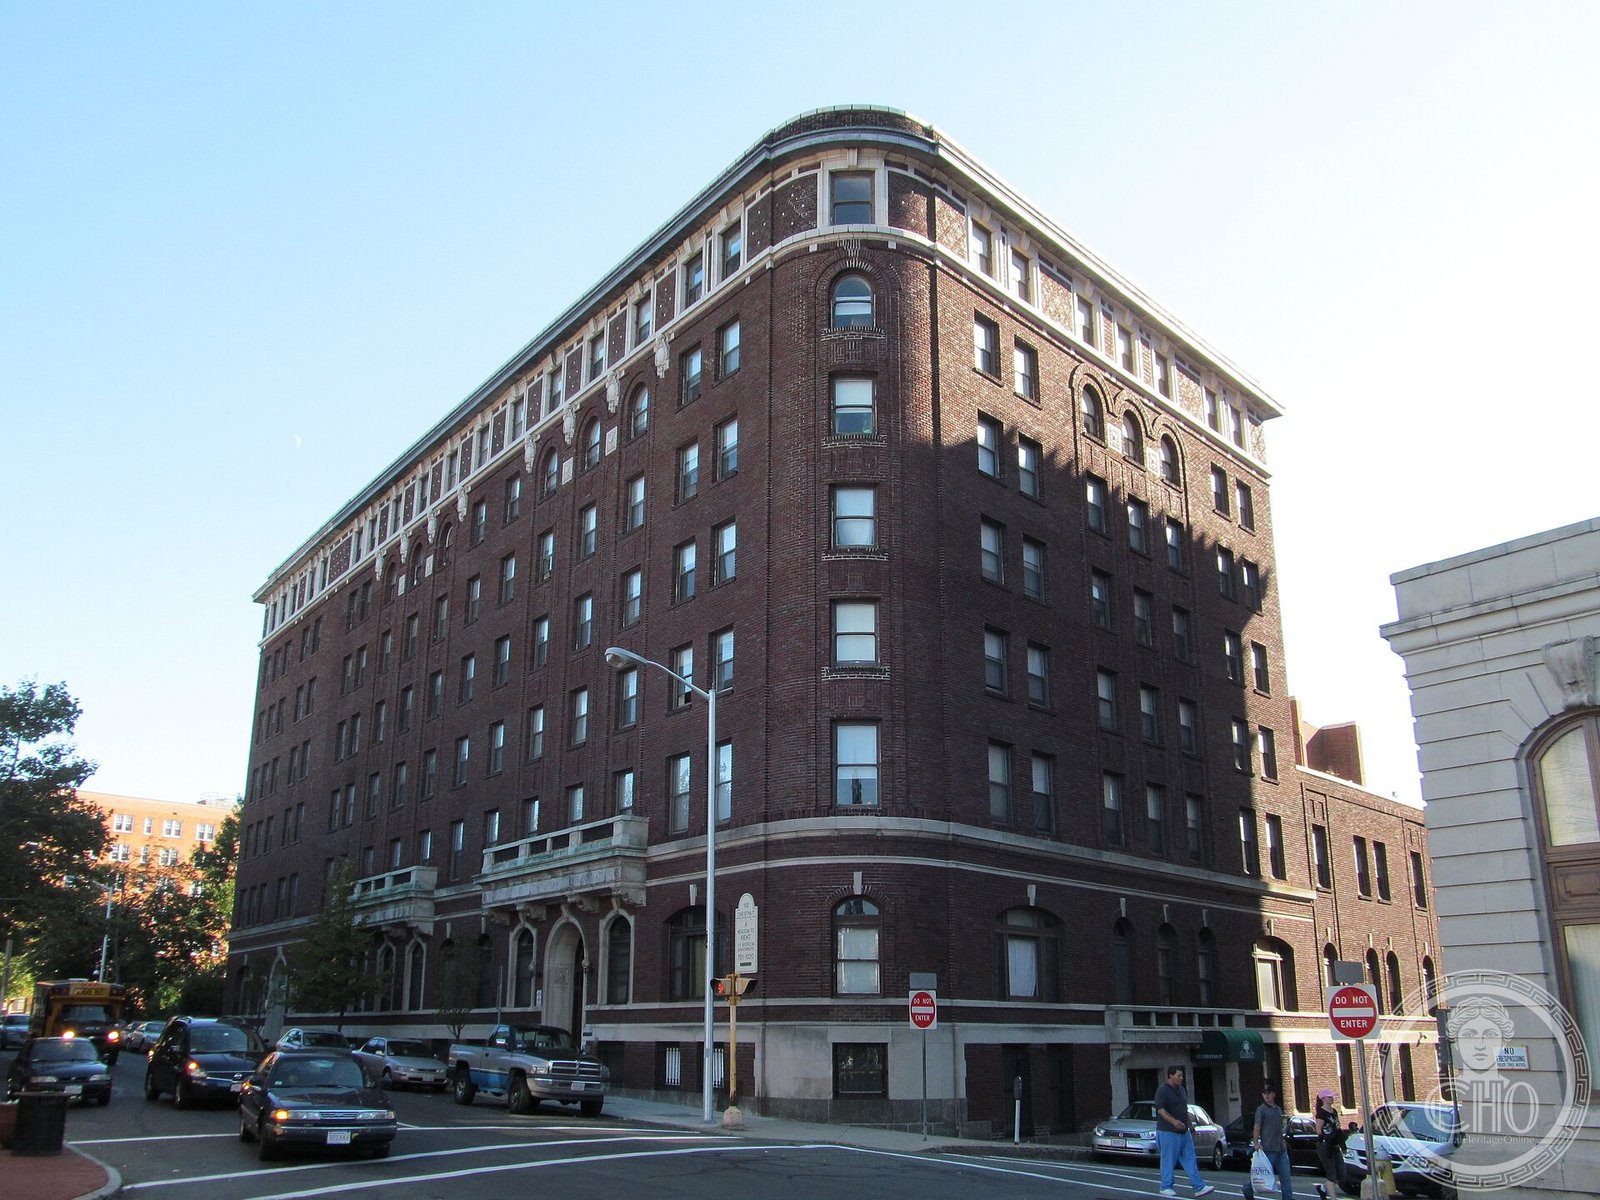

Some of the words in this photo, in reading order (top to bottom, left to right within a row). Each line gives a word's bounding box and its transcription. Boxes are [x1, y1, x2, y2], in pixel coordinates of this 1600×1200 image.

[1335, 996, 1347, 1004] DO
[1352, 996, 1368, 1004] NOT
[1340, 1020, 1368, 1028] ENTER
[1503, 1047, 1515, 1055] NO
